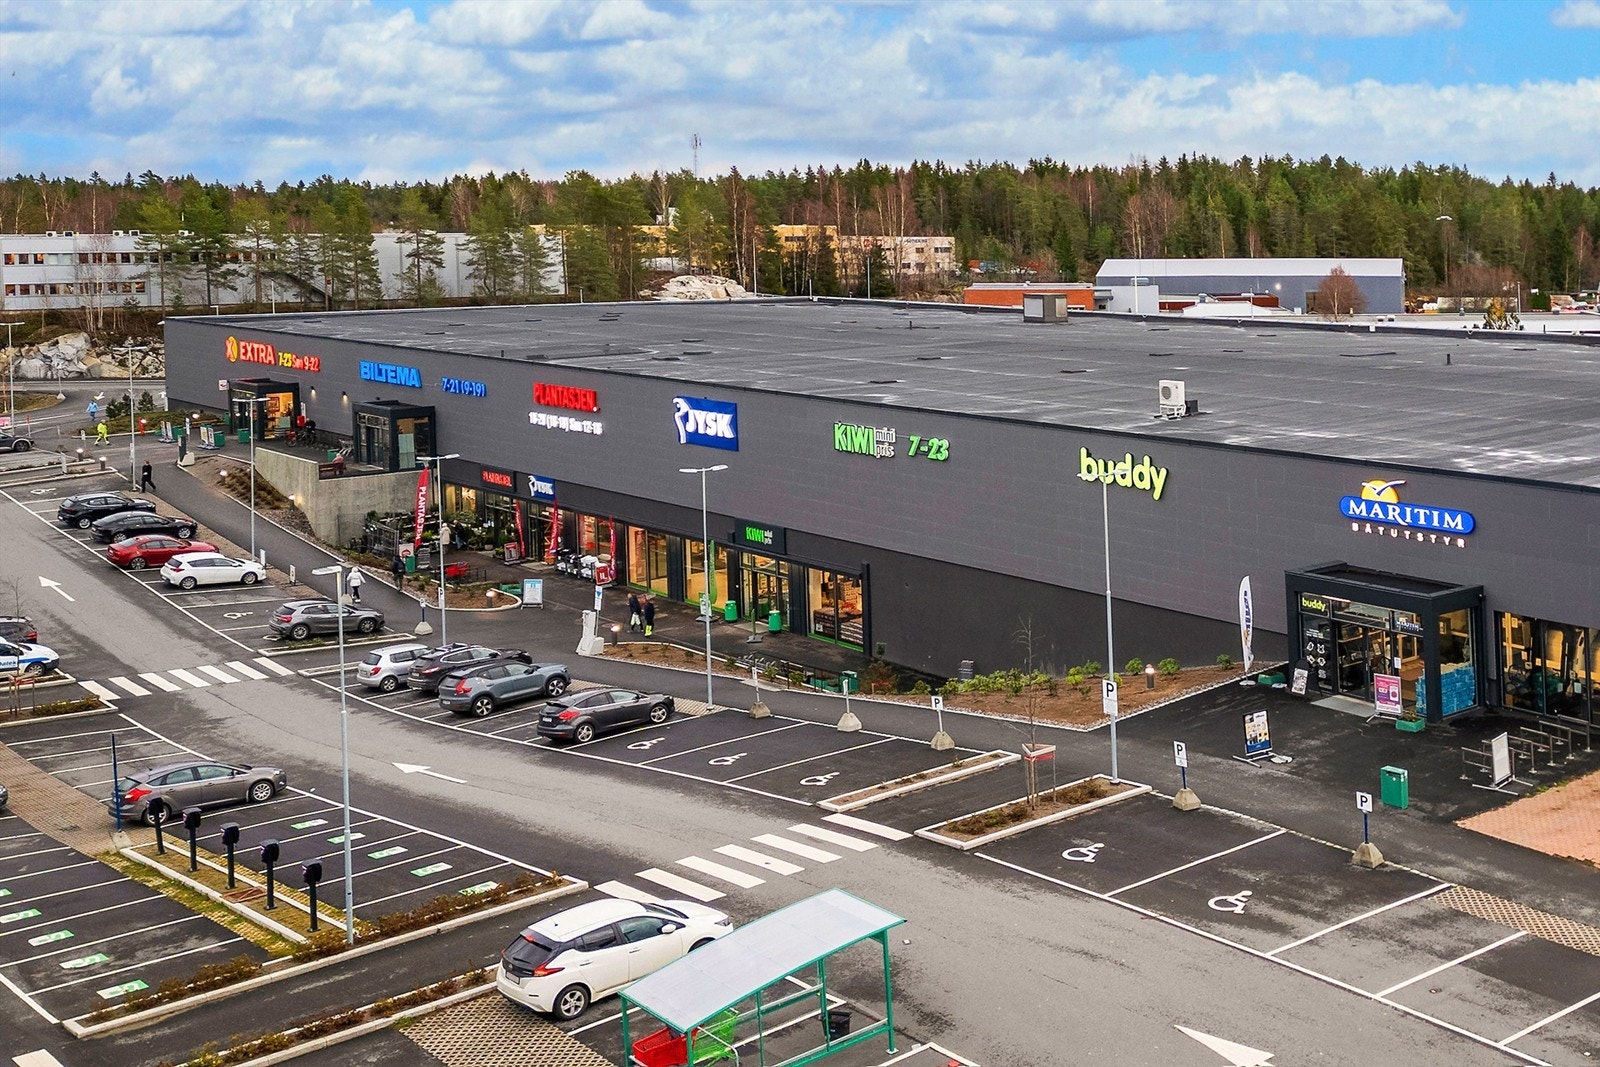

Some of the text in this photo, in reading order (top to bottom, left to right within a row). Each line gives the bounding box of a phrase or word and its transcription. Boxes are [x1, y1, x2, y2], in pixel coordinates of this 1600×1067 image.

[239, 341, 276, 365] EXTRA
[360, 361, 422, 388] BILTEMA
[441, 377, 459, 393] 7-21
[686, 408, 736, 438] JYSK
[833, 423, 950, 461] KIWI 7-23
[875, 427, 896, 443] mini
[875, 443, 895, 459] pris
[1080, 446, 1168, 500] buddy
[1348, 499, 1464, 530] MARITIM
[745, 526, 764, 543] KIWI
[1301, 597, 1327, 612] buddy
[1106, 682, 1115, 697] P
[934, 697, 940, 708] P
[1176, 744, 1183, 755] P
[1360, 795, 1368, 807] P
